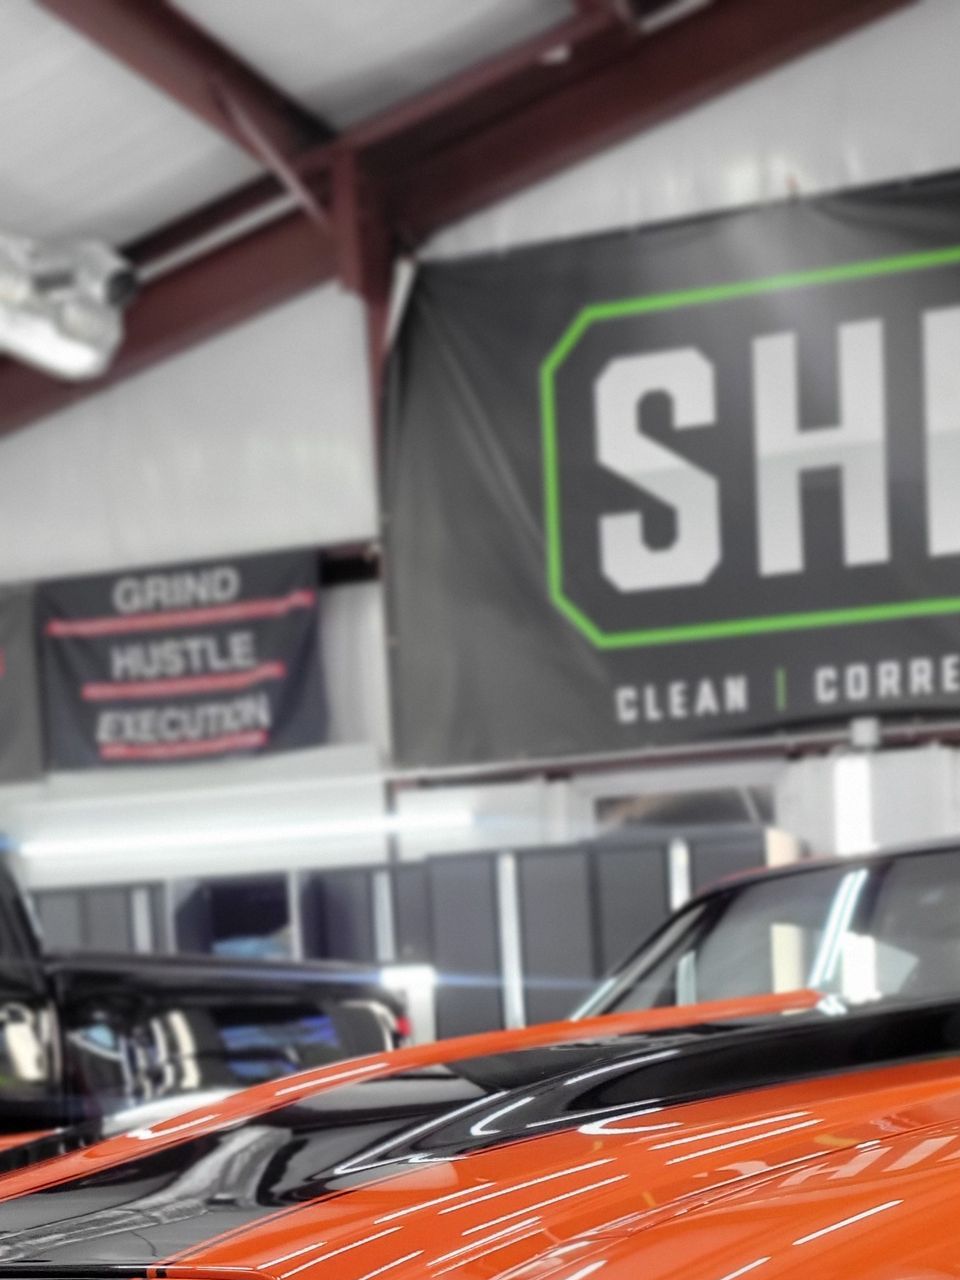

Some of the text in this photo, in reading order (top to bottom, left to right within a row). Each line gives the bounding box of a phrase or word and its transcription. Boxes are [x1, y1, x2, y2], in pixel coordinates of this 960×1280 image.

[111, 566, 241, 614] GRIND
[110, 632, 258, 680] HUSTLE
[615, 675, 748, 723] CLEAN
